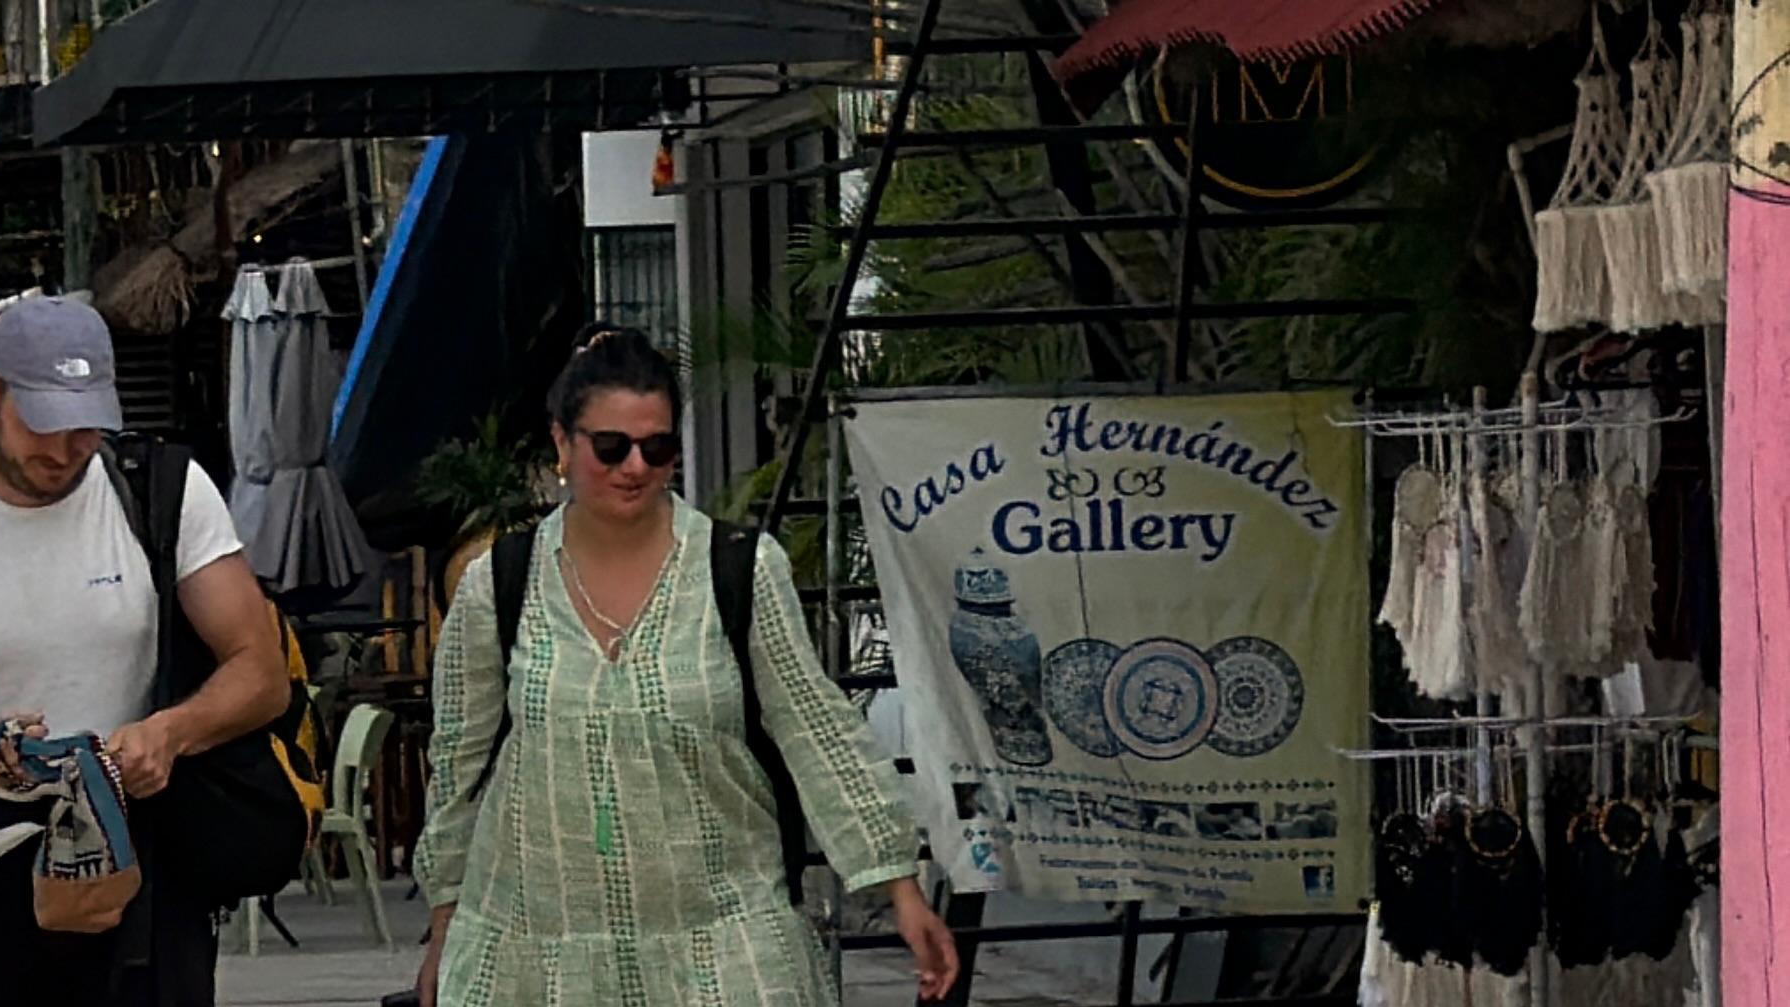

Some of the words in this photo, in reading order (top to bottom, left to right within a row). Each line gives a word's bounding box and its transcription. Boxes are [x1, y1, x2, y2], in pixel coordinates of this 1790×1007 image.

[881, 443, 1005, 533] Casa
[1039, 401, 1339, 529] Hernández
[991, 498, 1236, 562] Gallery
